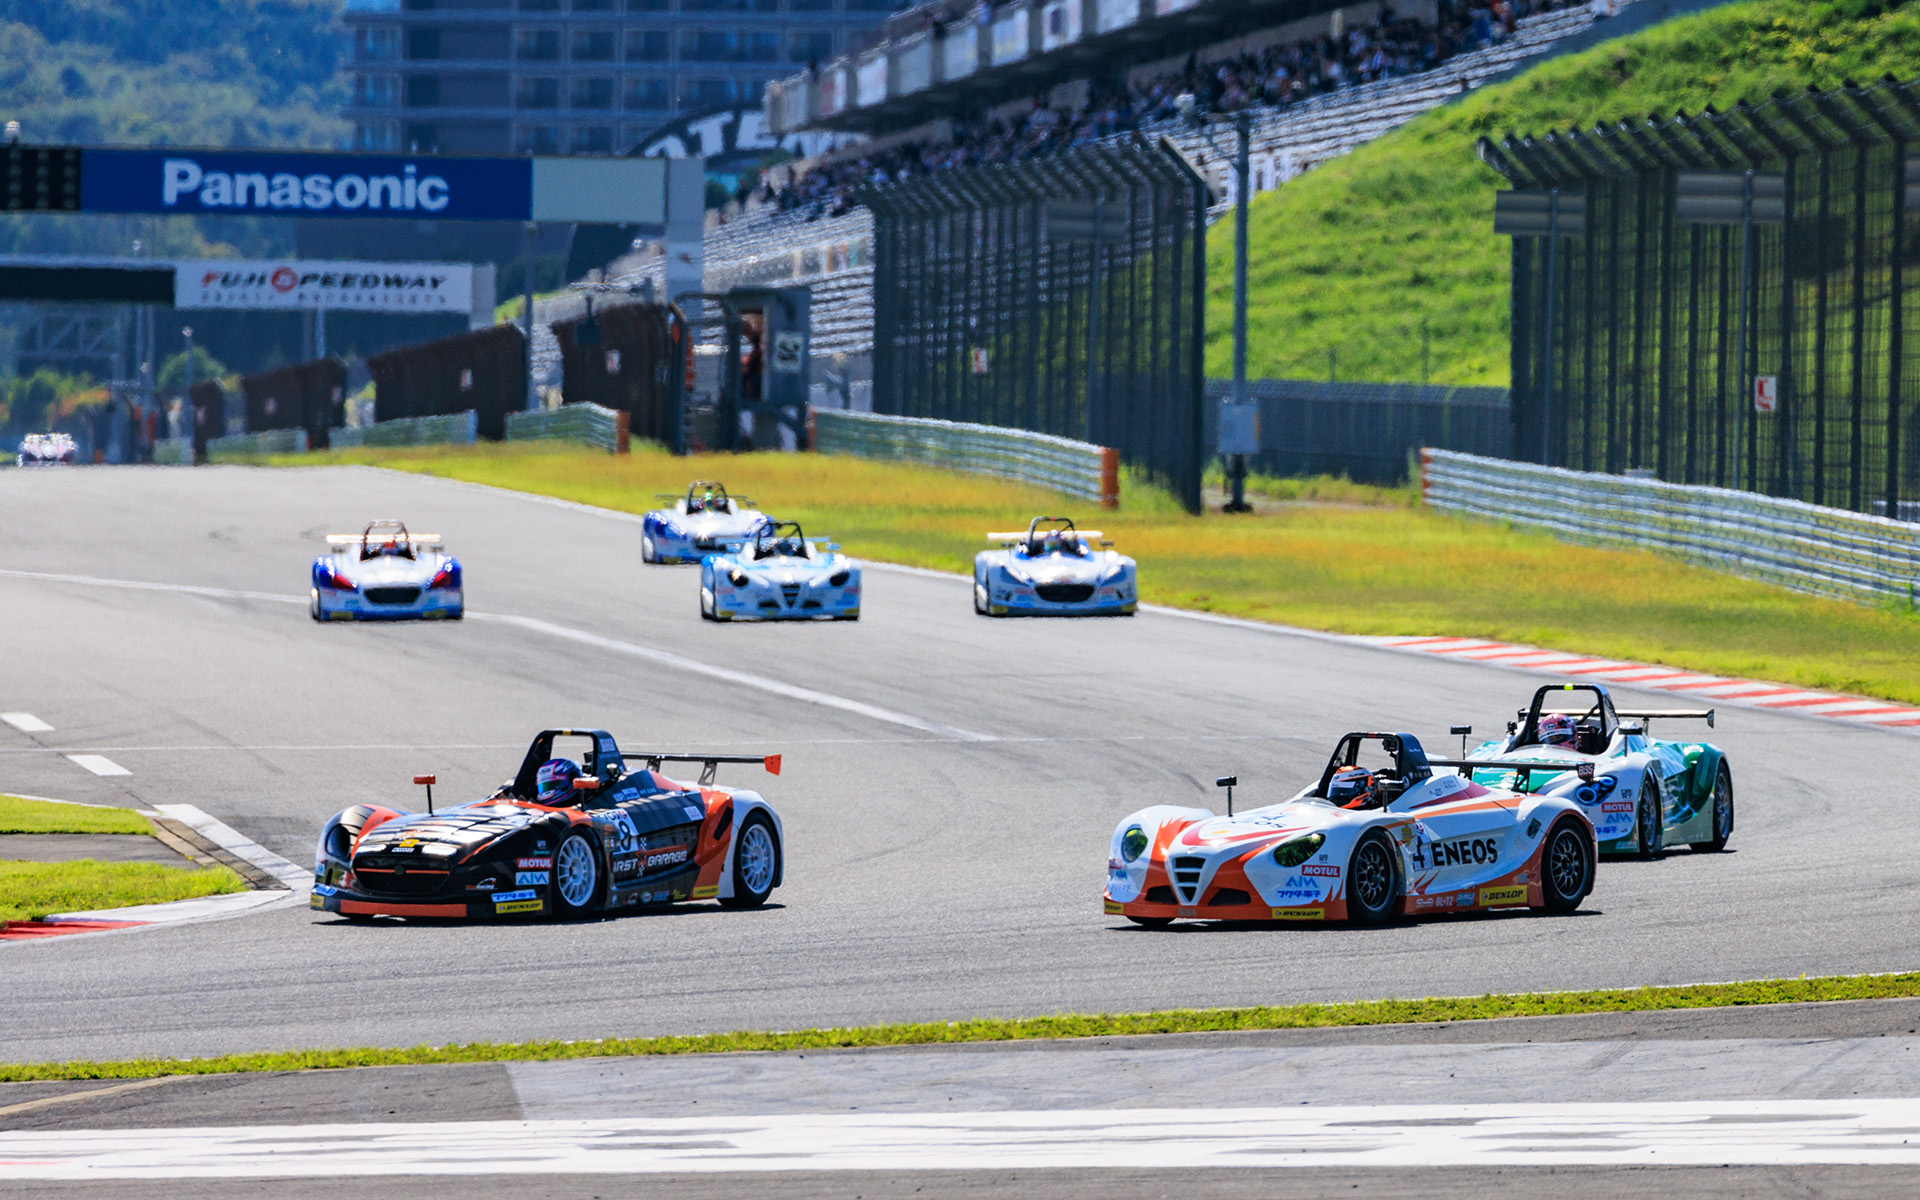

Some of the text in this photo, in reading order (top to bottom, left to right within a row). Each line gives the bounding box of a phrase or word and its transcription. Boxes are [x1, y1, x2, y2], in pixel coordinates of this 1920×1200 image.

[163, 158, 449, 211] Panasonic
[618, 820, 632, 851] 8
[647, 850, 688, 867] GARAGE
[1413, 836, 1425, 868] 4
[1430, 838, 1498, 867] ENEOS
[518, 858, 551, 868] MOTUL
[1303, 866, 1339, 876] MOTUL
[517, 872, 549, 885] AIM
[1285, 876, 1319, 888] AIM
[1489, 889, 1524, 900] DUNLOP
[506, 902, 541, 910] DUNLOP
